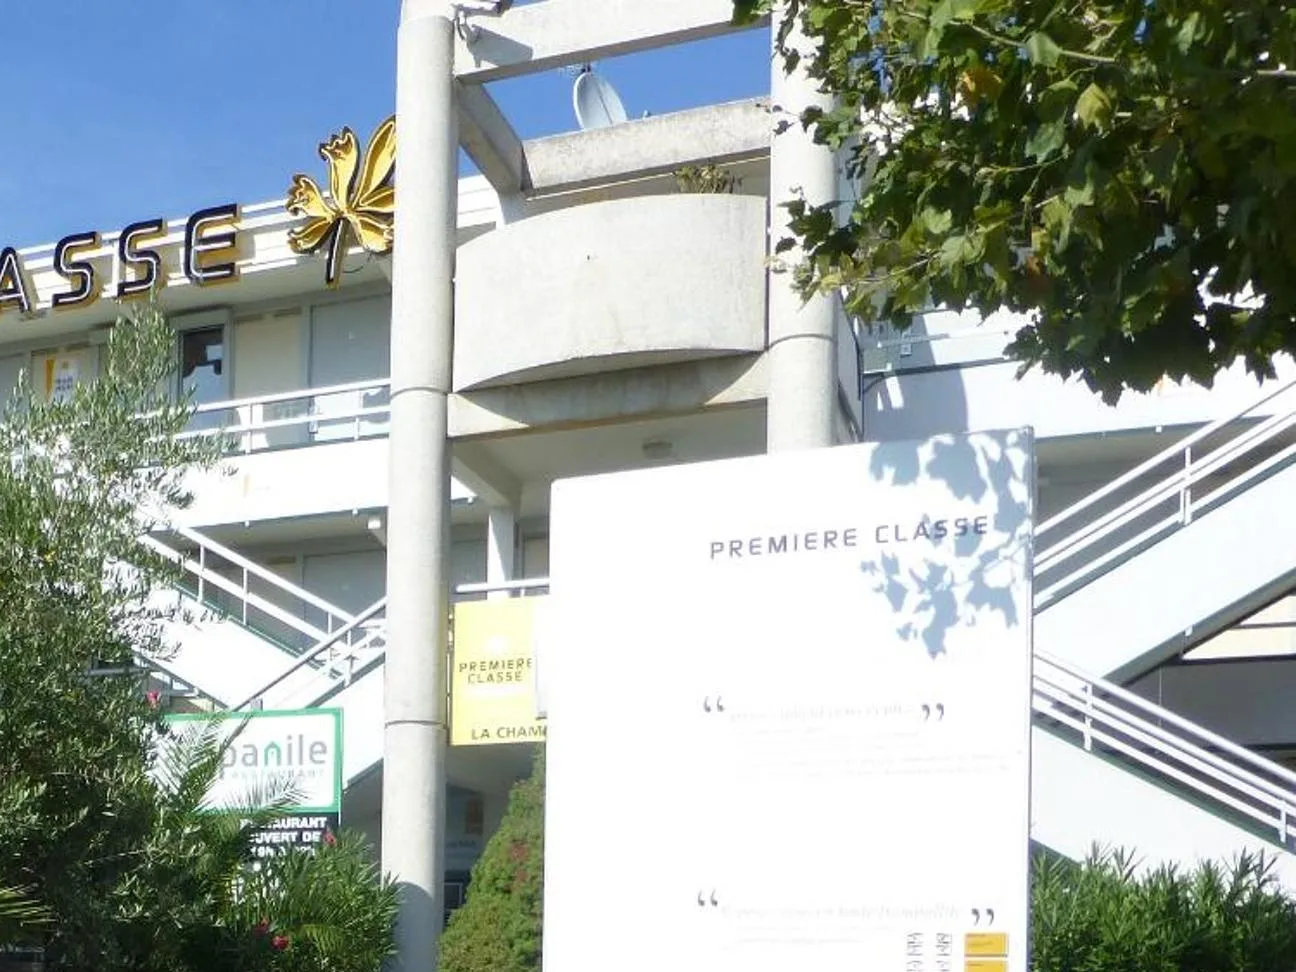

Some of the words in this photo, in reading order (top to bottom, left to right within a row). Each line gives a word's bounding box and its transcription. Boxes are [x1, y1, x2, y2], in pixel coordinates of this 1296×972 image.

[709, 527, 858, 560] PREMIERE
[874, 515, 990, 545] CLASSE
[458, 657, 533, 673] PREMIERE
[467, 670, 524, 685] CLASSE
[471, 728, 491, 741] LA
[496, 724, 547, 739] CHAM
[218, 733, 329, 780] panile
[240, 816, 327, 830] RAURANT
